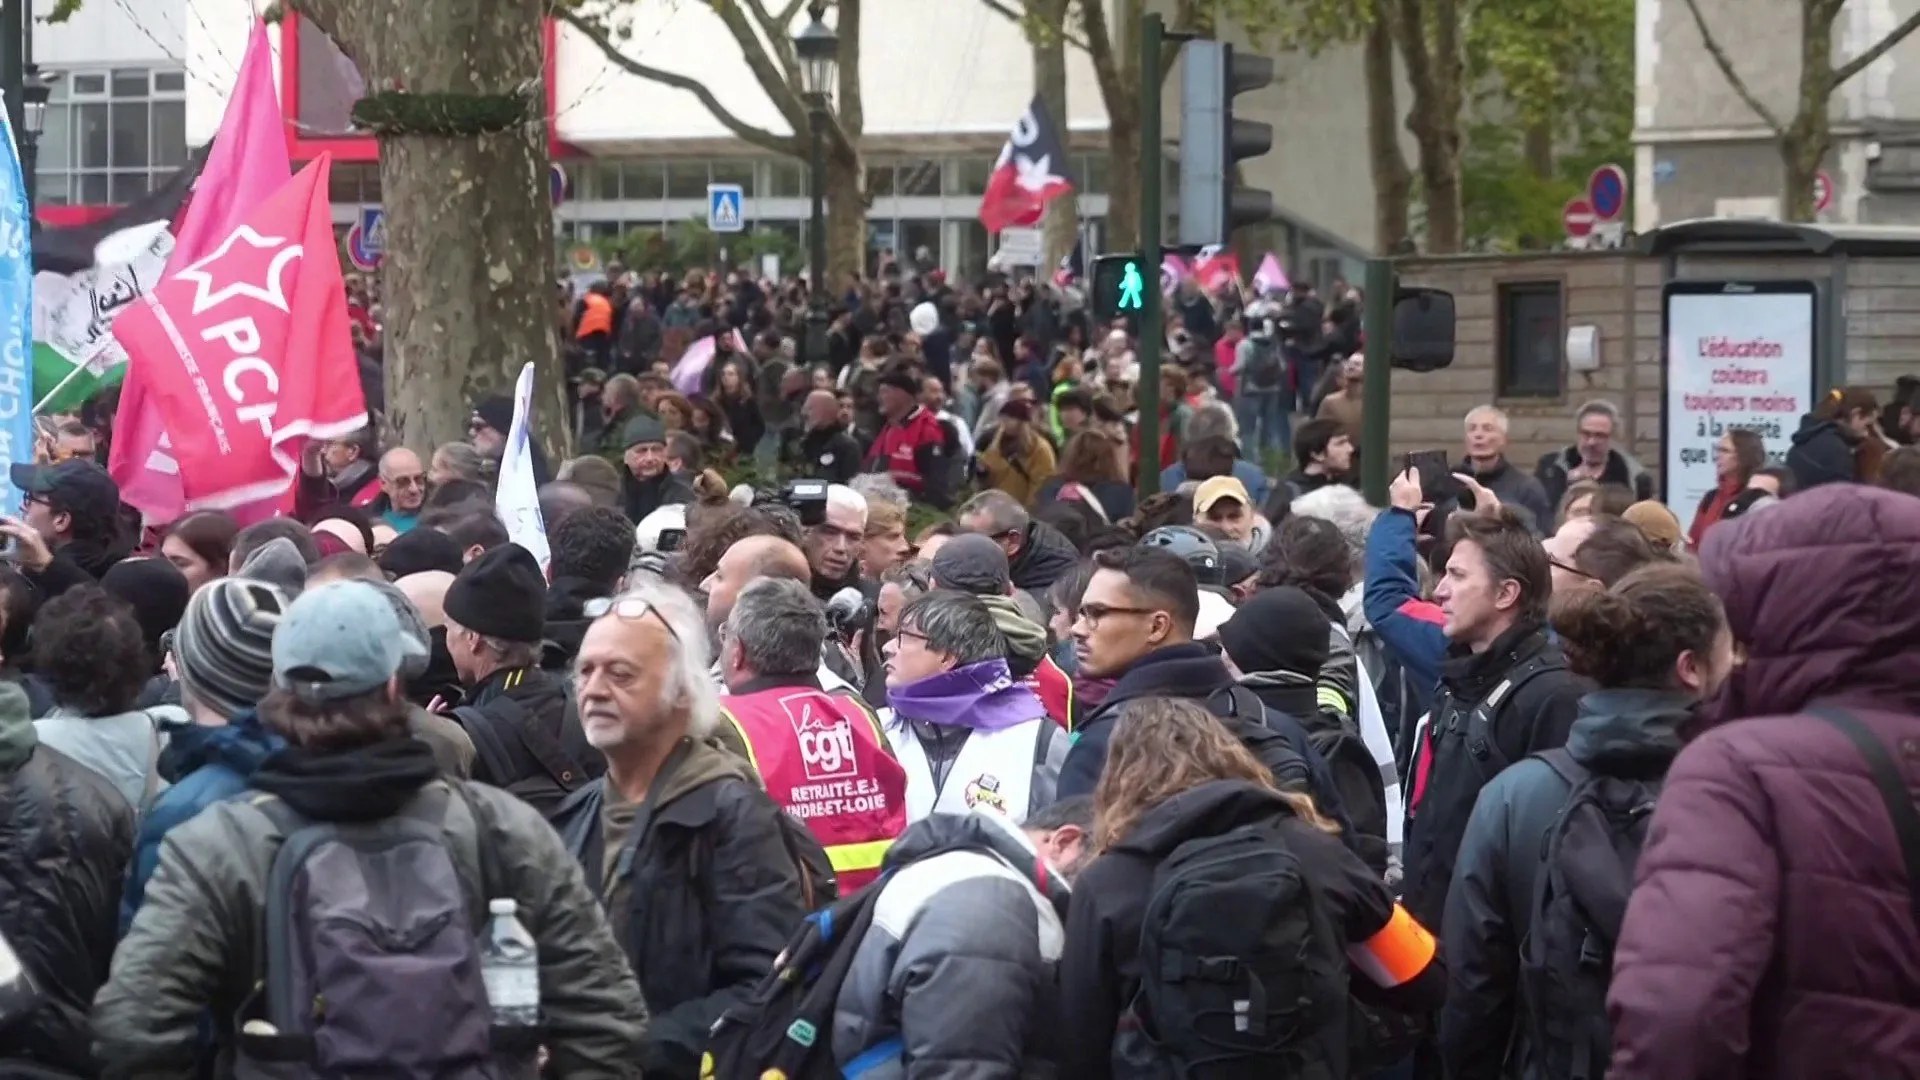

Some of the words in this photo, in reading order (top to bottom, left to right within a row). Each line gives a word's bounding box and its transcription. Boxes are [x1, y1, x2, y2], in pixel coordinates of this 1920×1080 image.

[1698, 335, 1782, 357] L'éducation
[1712, 363, 1767, 384] coûtera
[1684, 390, 1744, 416] toujours
[1750, 390, 1796, 412] moins
[1697, 415, 1706, 437] à
[1680, 447, 1707, 468] que
[800, 703, 836, 734] la
[800, 720, 855, 773] cgt
